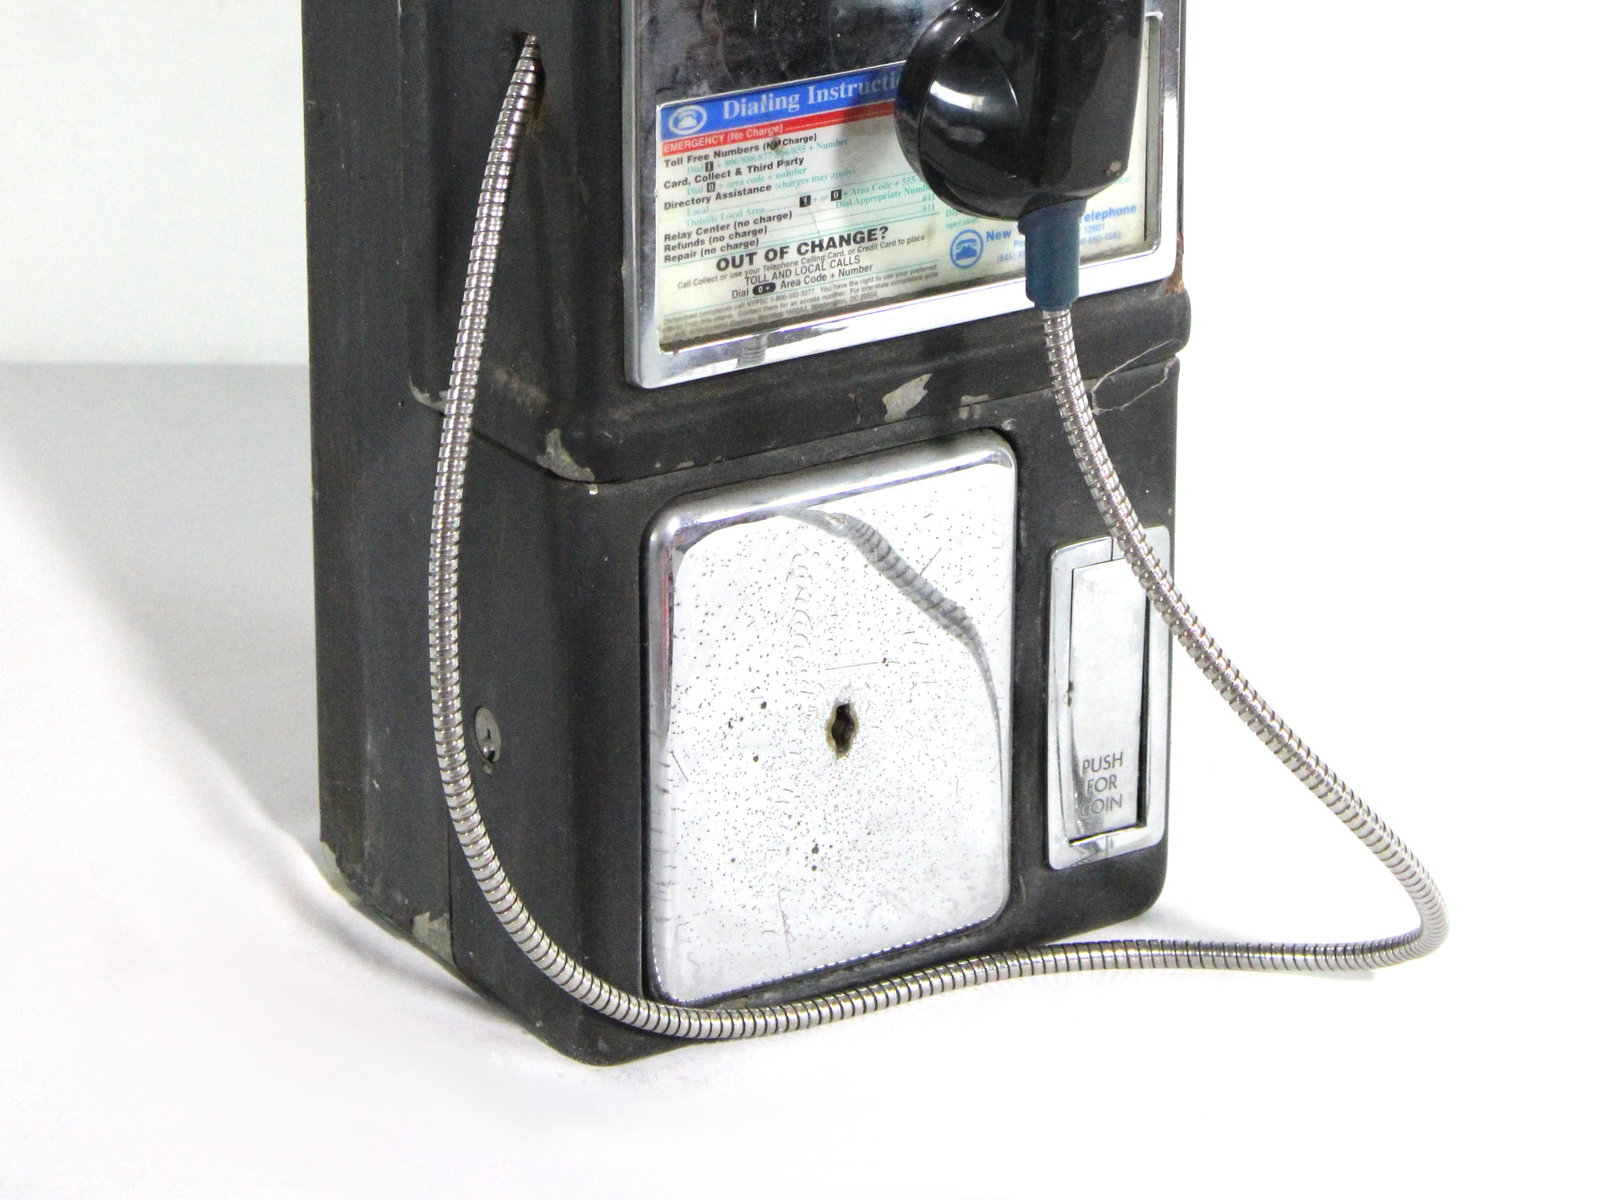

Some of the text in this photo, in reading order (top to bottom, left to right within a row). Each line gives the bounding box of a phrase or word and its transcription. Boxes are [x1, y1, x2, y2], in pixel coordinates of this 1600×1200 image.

[723, 72, 899, 120] Dialing Instructi
[664, 123, 784, 153] EMERGENCY (No Charge)
[664, 157, 683, 168] Toll
[687, 154, 710, 164] Free
[714, 145, 760, 159] Numbers
[782, 133, 818, 146] Charge)
[816, 138, 849, 150] Number
[664, 156, 805, 190] Card, Collect & Third Party
[775, 167, 807, 179] number
[871, 182, 891, 191] Code
[664, 196, 711, 211] Directory
[715, 184, 772, 201] Assistance
[811, 174, 828, 183] may
[663, 191, 902, 243] Relay Center (no charge) Dial Appropriate
[986, 205, 1137, 242] New elephone
[663, 250, 697, 263] Repair
[700, 247, 716, 258] (no
[719, 237, 760, 253] charge)
[922, 204, 935, 212] 611
[663, 238, 705, 252] Refunds
[708, 235, 725, 246] (no
[728, 225, 768, 240] charge)
[715, 226, 889, 272] OUT OF CHANGE?
[677, 280, 691, 289] Call
[693, 274, 718, 287] Collect
[730, 271, 743, 279] use
[744, 268, 760, 278] your
[763, 259, 799, 274] Telephone
[801, 252, 826, 267] Calling
[857, 243, 878, 253] Credit
[880, 240, 896, 249] Card
[898, 237, 905, 245] to
[907, 234, 925, 245] place
[745, 254, 861, 286] TOLL AND LOCAL CALLS
[832, 281, 848, 290] have
[849, 280, 858, 288] the
[860, 277, 874, 287] right
[910, 264, 937, 275] preferred
[732, 264, 873, 300] Dial Area Code Number
[850, 286, 860, 294] For
[1082, 751, 1123, 776] PUSH
[1087, 774, 1117, 795] FOR
[1081, 793, 1123, 818] COIN
